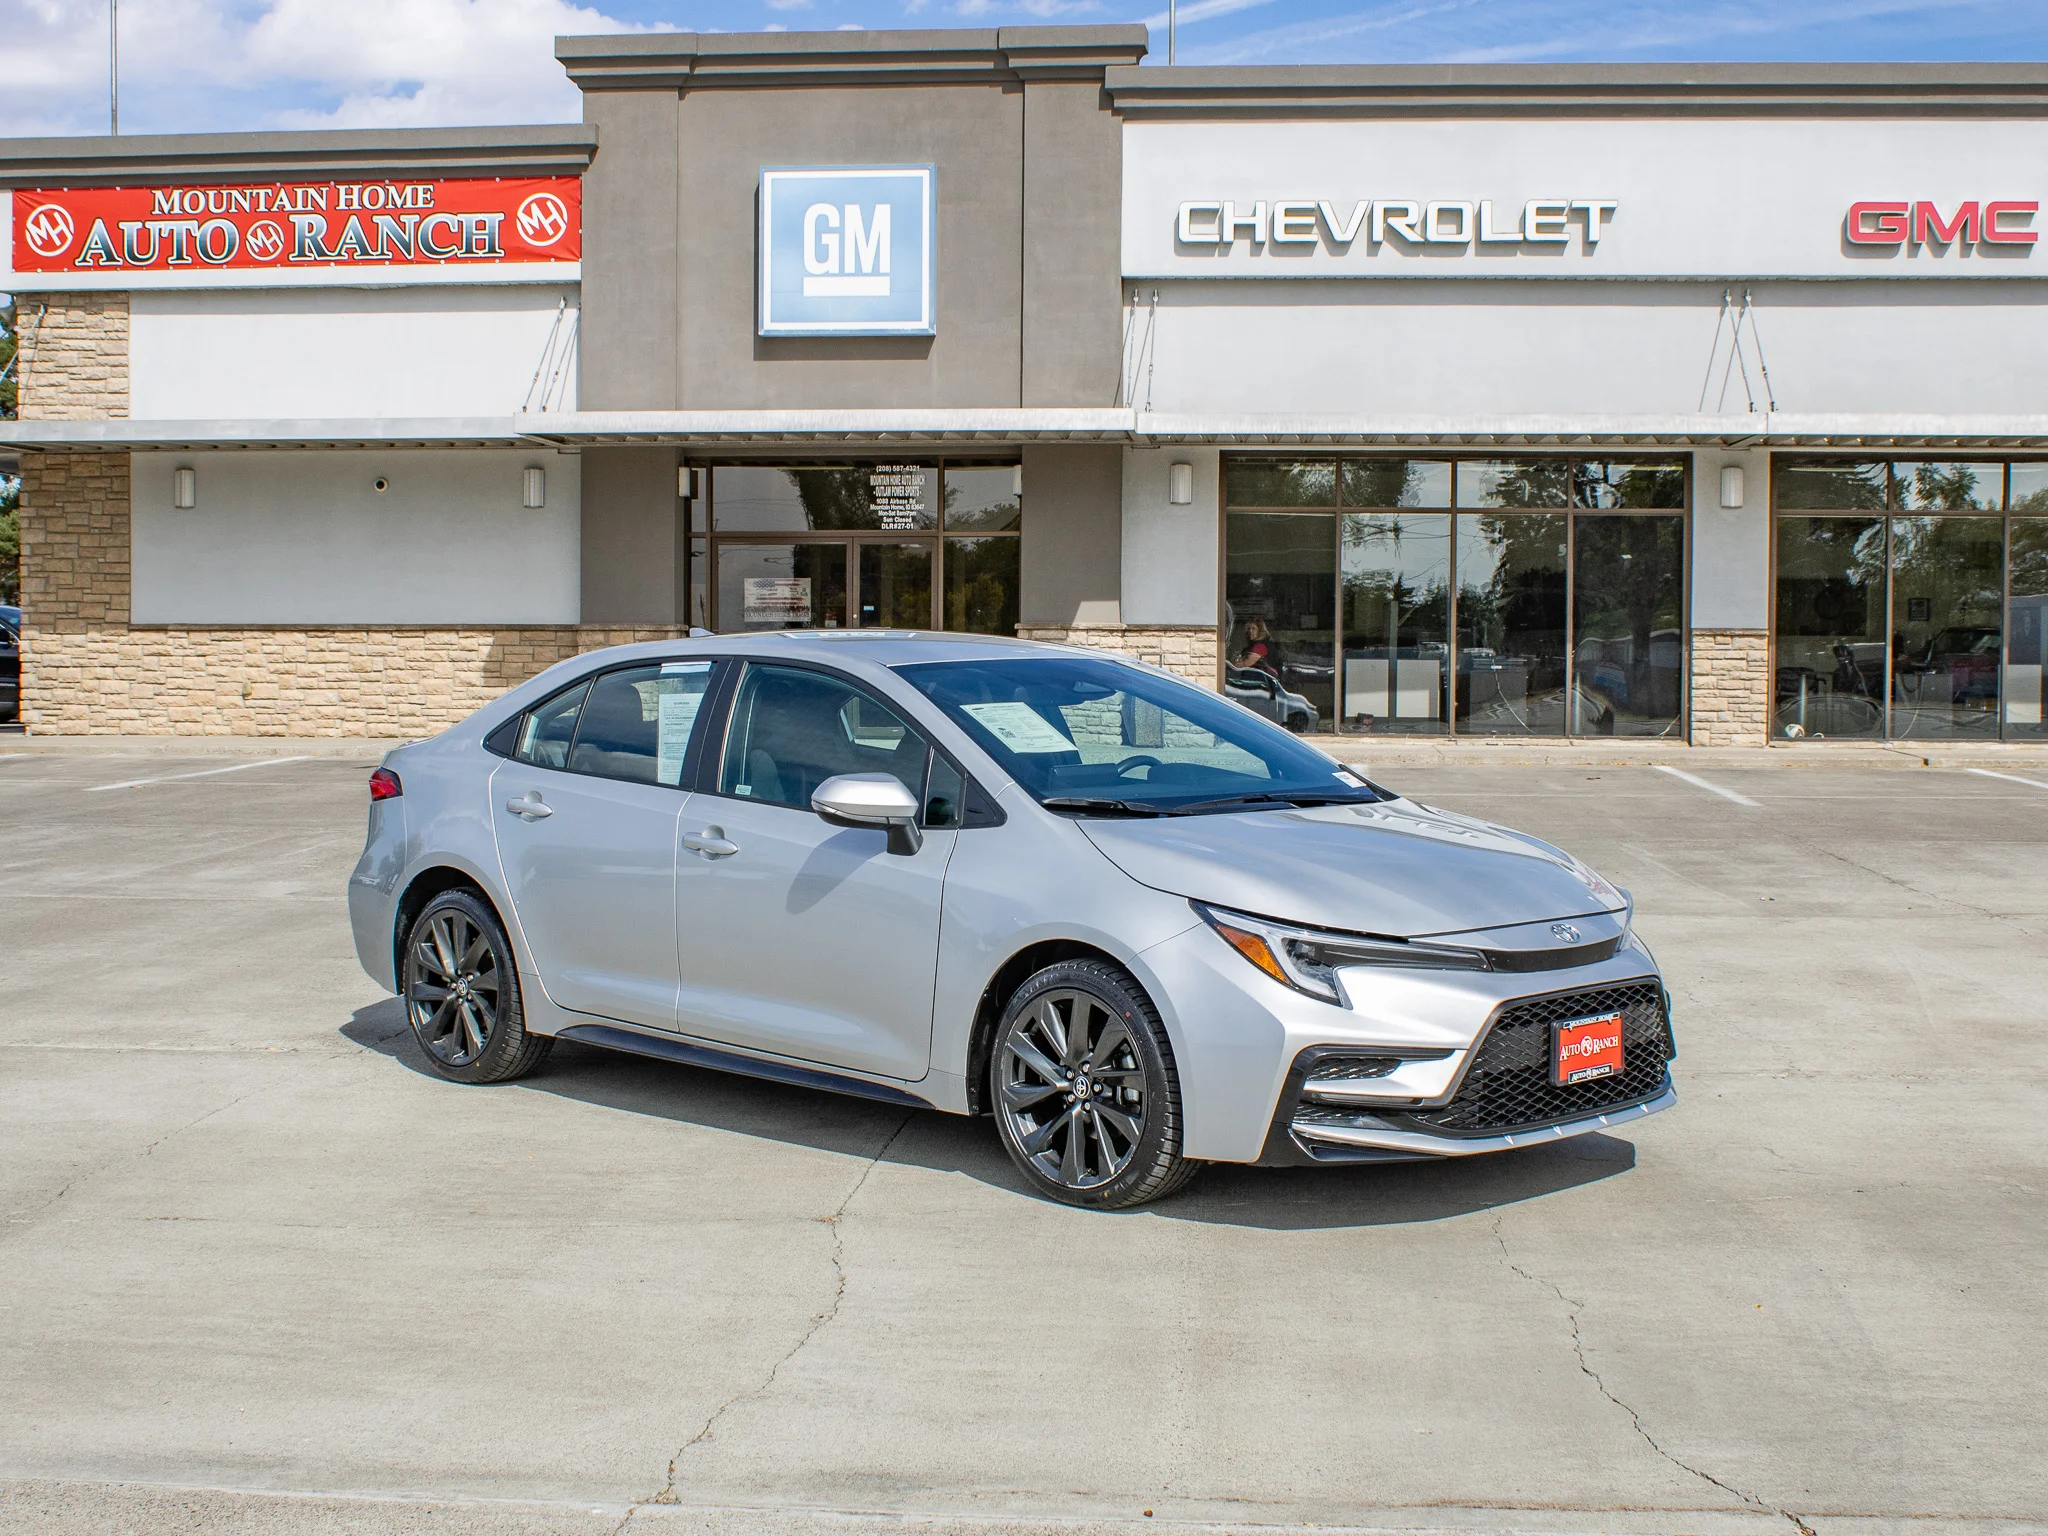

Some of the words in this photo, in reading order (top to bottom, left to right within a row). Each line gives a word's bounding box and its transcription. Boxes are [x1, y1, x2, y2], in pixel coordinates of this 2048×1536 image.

[151, 186, 329, 215] MOUNTAIN
[335, 184, 435, 210] HOME
[74, 217, 240, 266] AUTO
[288, 212, 505, 262] RANCH
[803, 203, 891, 275] GM
[1176, 199, 1618, 244] CHEVROLET
[1846, 201, 2039, 244] GMC
[876, 465, 892, 473] (208)
[1559, 1044, 1580, 1061] AUTO
[1593, 1036, 1619, 1054] RANCH
